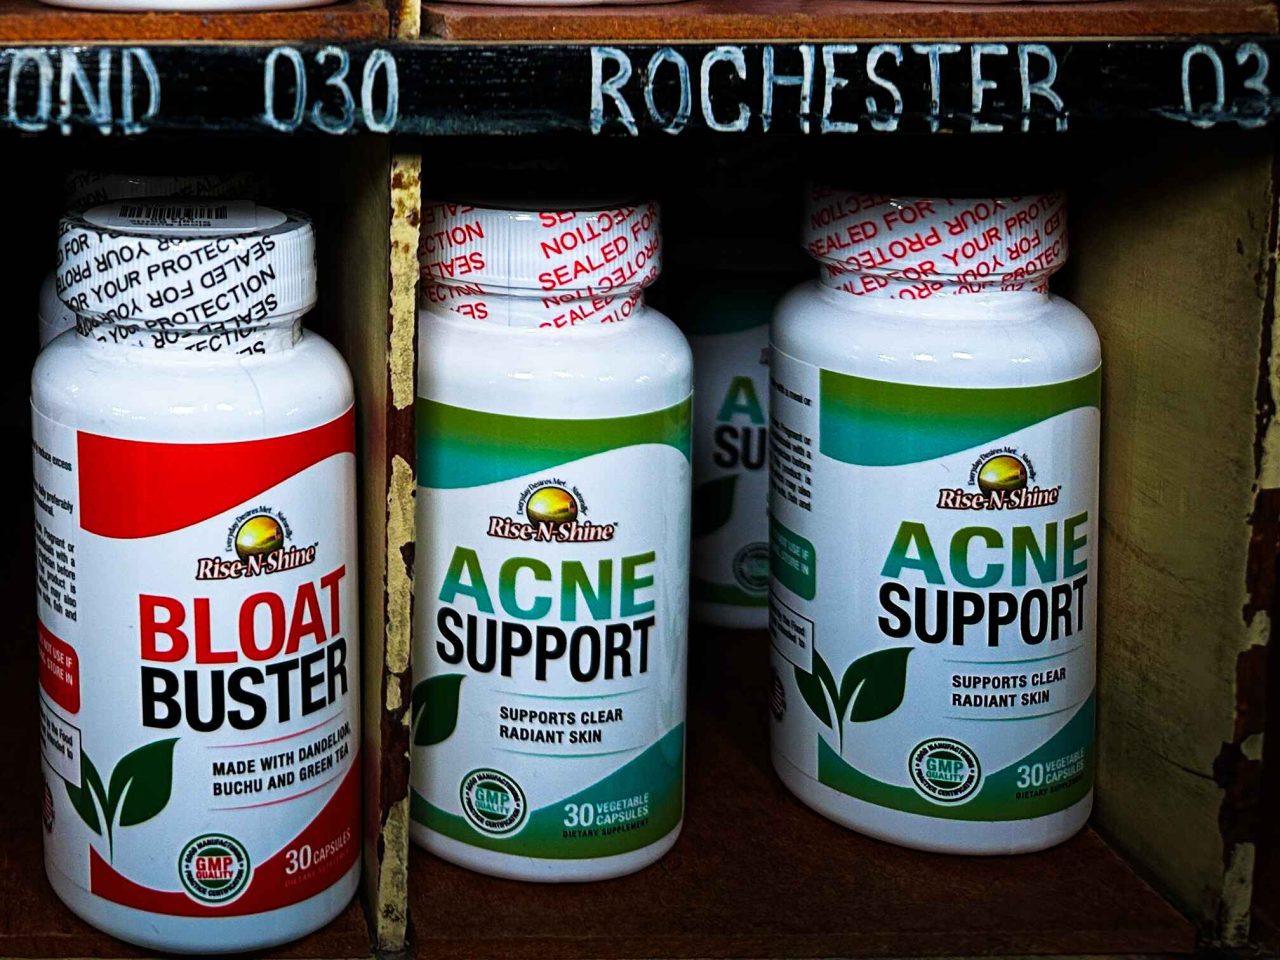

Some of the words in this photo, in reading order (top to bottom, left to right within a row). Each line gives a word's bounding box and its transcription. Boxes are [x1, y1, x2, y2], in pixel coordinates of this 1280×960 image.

[263, 46, 400, 135] 030
[589, 43, 1070, 135] ROCHESTER
[883, 200, 935, 231] FOR
[201, 235, 276, 289] SEALED
[943, 226, 1003, 268] YOUR
[538, 237, 629, 292] SEALED
[148, 280, 194, 309] FOR
[937, 486, 1060, 510] Rise-N-Shine
[487, 516, 615, 543] Rise-N-Shine
[196, 543, 317, 580] Rise-N-Shine
[880, 511, 1088, 588] ACNE
[439, 545, 656, 622] ACNE
[139, 564, 346, 664] BLOAT
[878, 574, 1088, 647] SUPPORT
[436, 606, 656, 683] SUPPORT
[140, 637, 348, 733] BUSTER
[952, 674, 1027, 689] SUPPORTS
[1032, 667, 1067, 686] CLEAR
[499, 706, 576, 726] SUPPORTS
[580, 708, 623, 725] CLEAR
[952, 693, 1016, 708] RADIANT
[1021, 690, 1050, 706] SKIN
[499, 725, 565, 743] RADIANT
[569, 729, 602, 744] SKIN
[213, 779, 263, 796] BUCHU
[267, 771, 295, 790] AND
[299, 756, 333, 783] GREEN
[1017, 762, 1043, 788] 30
[475, 788, 510, 804] GMP
[596, 793, 649, 814] VEGETABLE
[564, 803, 594, 828] 30
[596, 805, 649, 826] CAPSULES
[284, 844, 312, 875] 30
